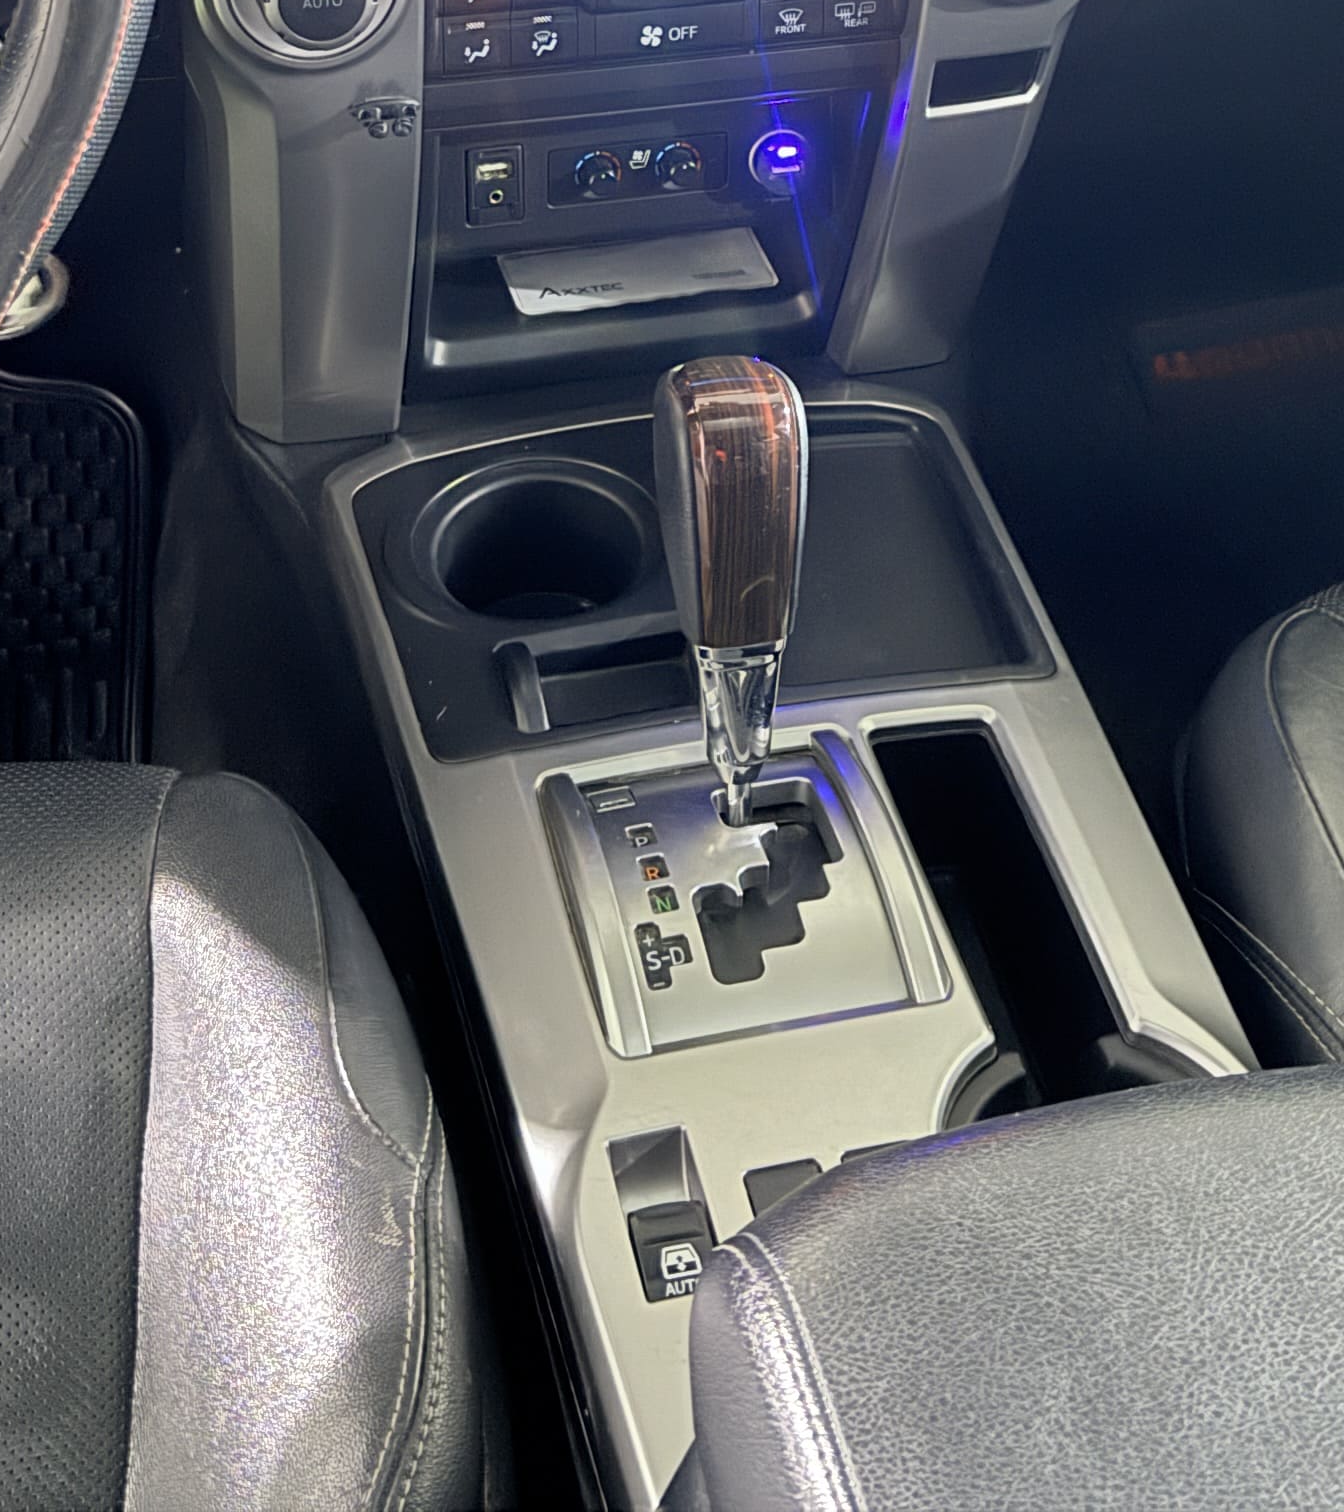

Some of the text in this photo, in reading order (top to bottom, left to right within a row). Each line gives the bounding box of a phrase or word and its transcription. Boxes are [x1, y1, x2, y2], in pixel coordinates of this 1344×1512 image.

[775, 23, 806, 35] FRONT
[844, 17, 869, 29] REAR
[668, 25, 699, 41] OFF
[539, 282, 624, 300] AXXTEC
[634, 836, 649, 848] P
[645, 866, 661, 881] R
[655, 898, 672, 913] N
[665, 1278, 700, 1297] AUT
